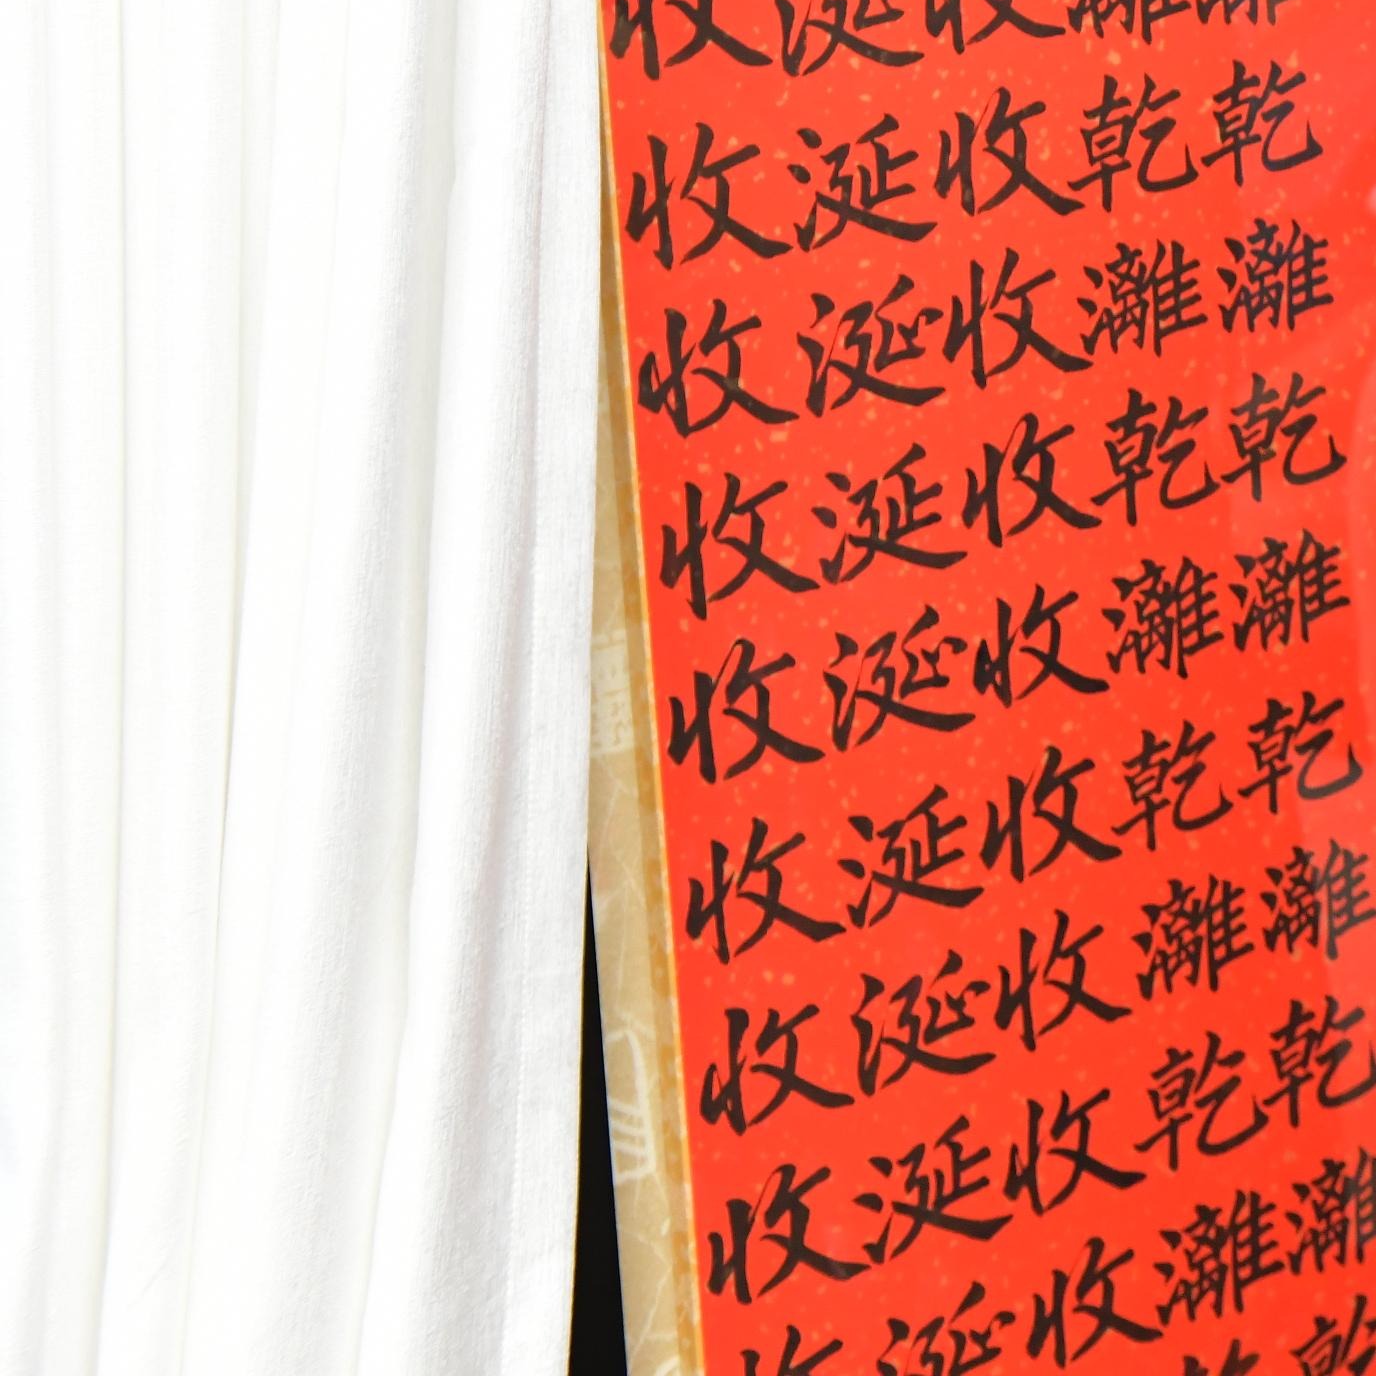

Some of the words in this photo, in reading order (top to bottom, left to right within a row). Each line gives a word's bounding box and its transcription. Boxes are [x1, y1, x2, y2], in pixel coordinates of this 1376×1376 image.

[625, 60, 1322, 269] 收涎收乾乾
[660, 372, 1347, 619] 收涎收乾乾
[685, 691, 1364, 965] 收涎收乾乾
